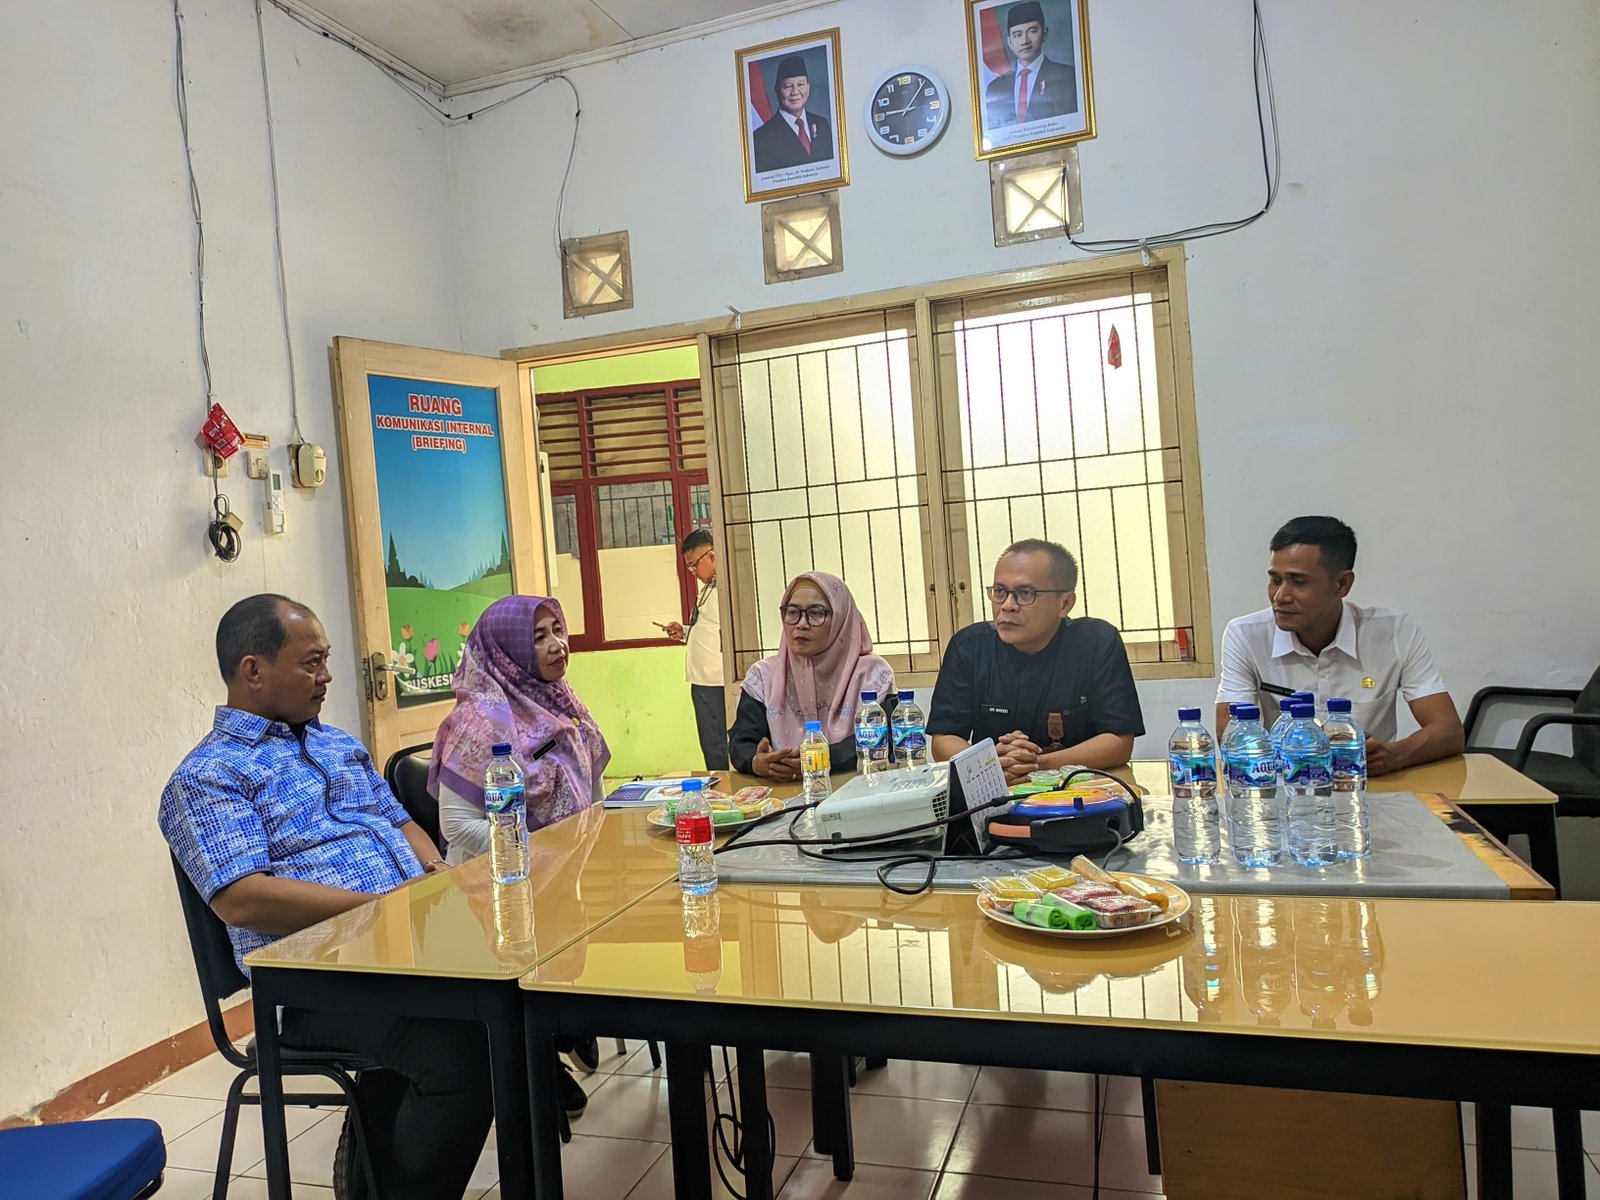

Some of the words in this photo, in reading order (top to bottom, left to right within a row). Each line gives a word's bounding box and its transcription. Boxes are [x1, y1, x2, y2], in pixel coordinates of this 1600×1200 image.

[887, 84, 895, 93] 11
[877, 97, 890, 107] 10
[929, 100, 940, 110] 3
[926, 115, 937, 123] 4
[880, 126, 890, 134] 8
[889, 134, 900, 142] 7
[408, 393, 462, 416] RUANG
[376, 415, 444, 432] KOMUNIKASI
[447, 420, 494, 437] INTERNAL
[412, 435, 466, 453] (BRIEFING)
[858, 730, 879, 739] AQUA
[1252, 761, 1276, 774] AQU
